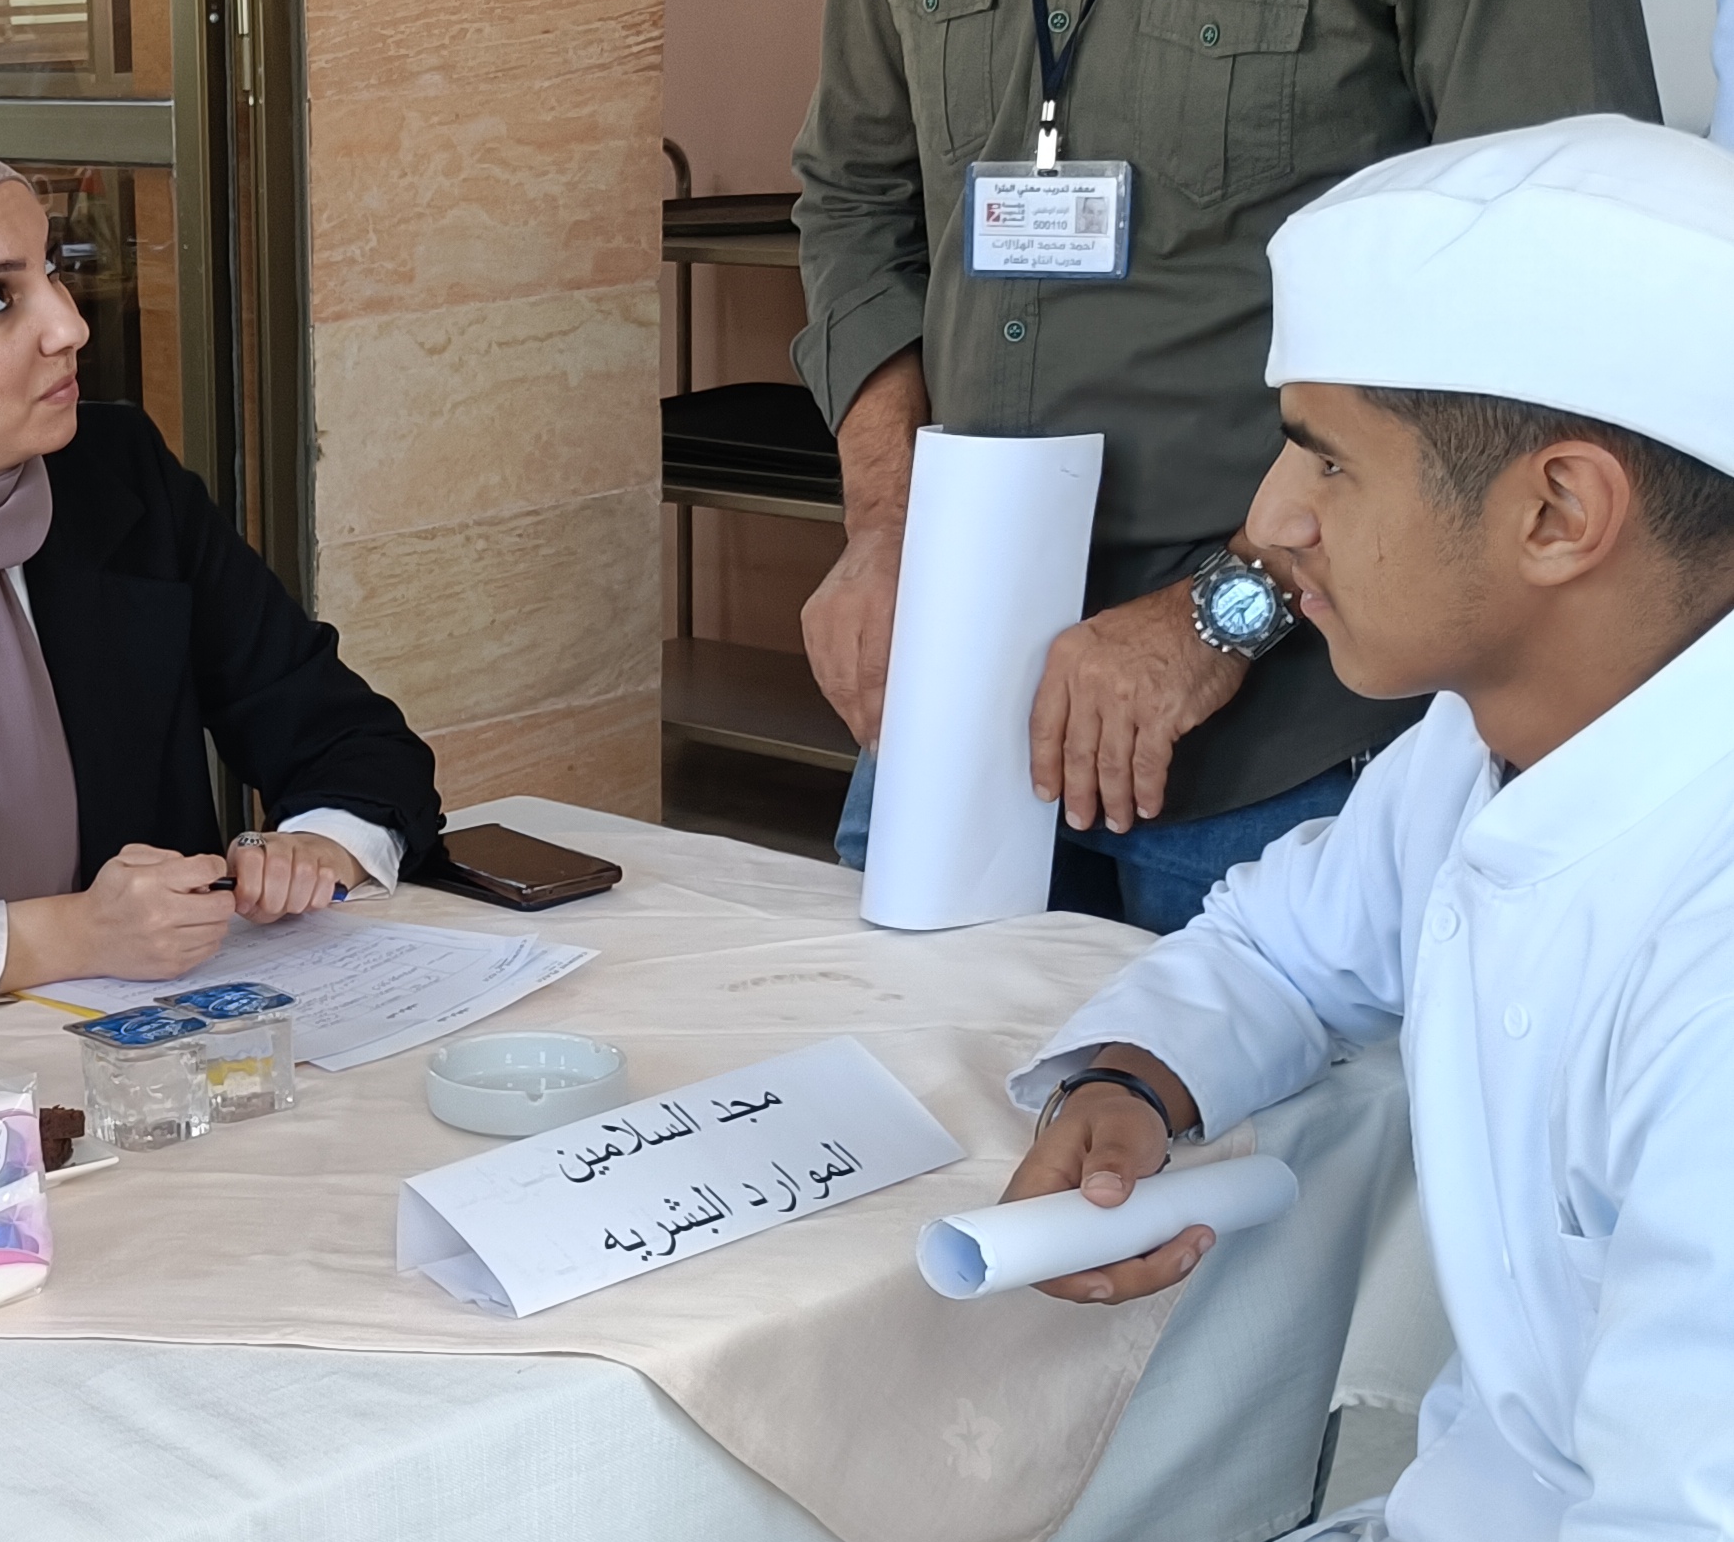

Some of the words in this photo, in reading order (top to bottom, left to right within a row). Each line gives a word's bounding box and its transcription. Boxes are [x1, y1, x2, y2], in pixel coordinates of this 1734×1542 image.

[556, 1100, 700, 1184] السلامين
[711, 1088, 783, 1125] مجد
[746, 1139, 863, 1214] الموارد
[602, 1183, 733, 1263] البشريه
